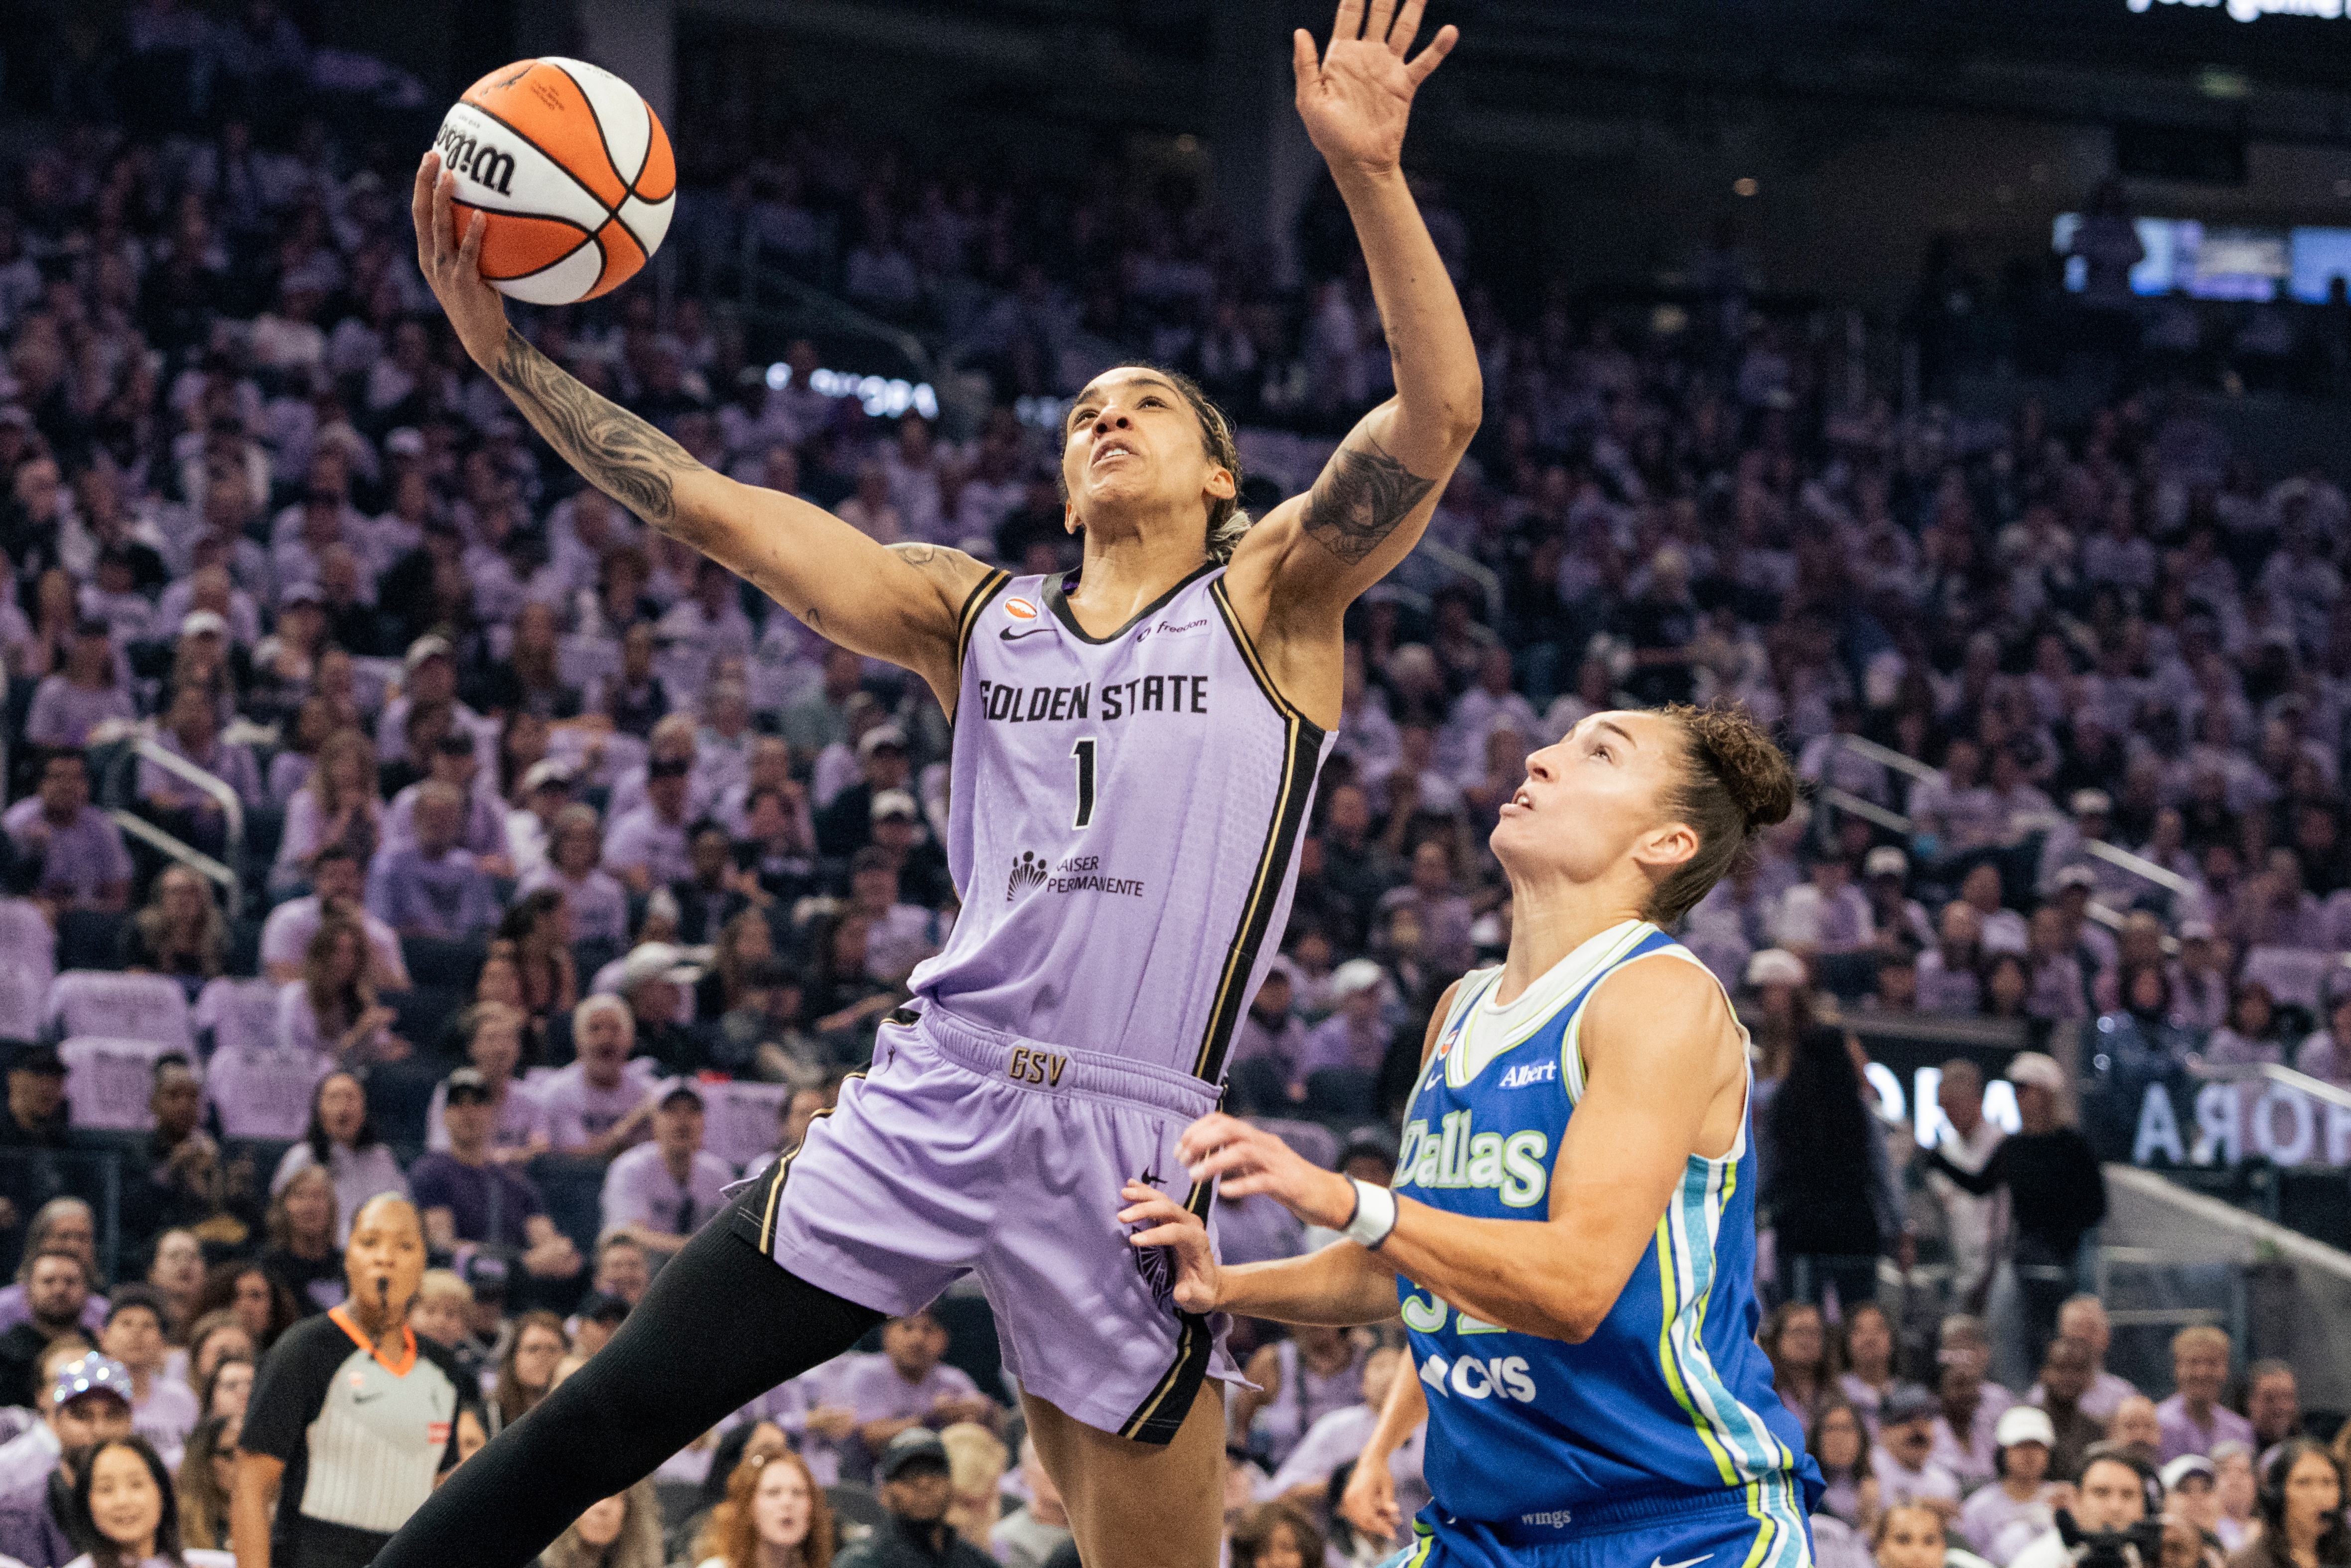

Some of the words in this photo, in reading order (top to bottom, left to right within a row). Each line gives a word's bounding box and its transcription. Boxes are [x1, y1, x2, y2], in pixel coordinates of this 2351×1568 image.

[1156, 619, 1207, 633] freedom
[1102, 675, 1208, 721] STATE
[1069, 737, 1098, 830] 1
[1057, 856, 1099, 872] AISER
[1009, 1046, 1067, 1087] GSV
[1499, 1060, 1556, 1087] Albert
[1451, 1354, 1536, 1403] CVS
[1521, 1510, 1571, 1529] wings
